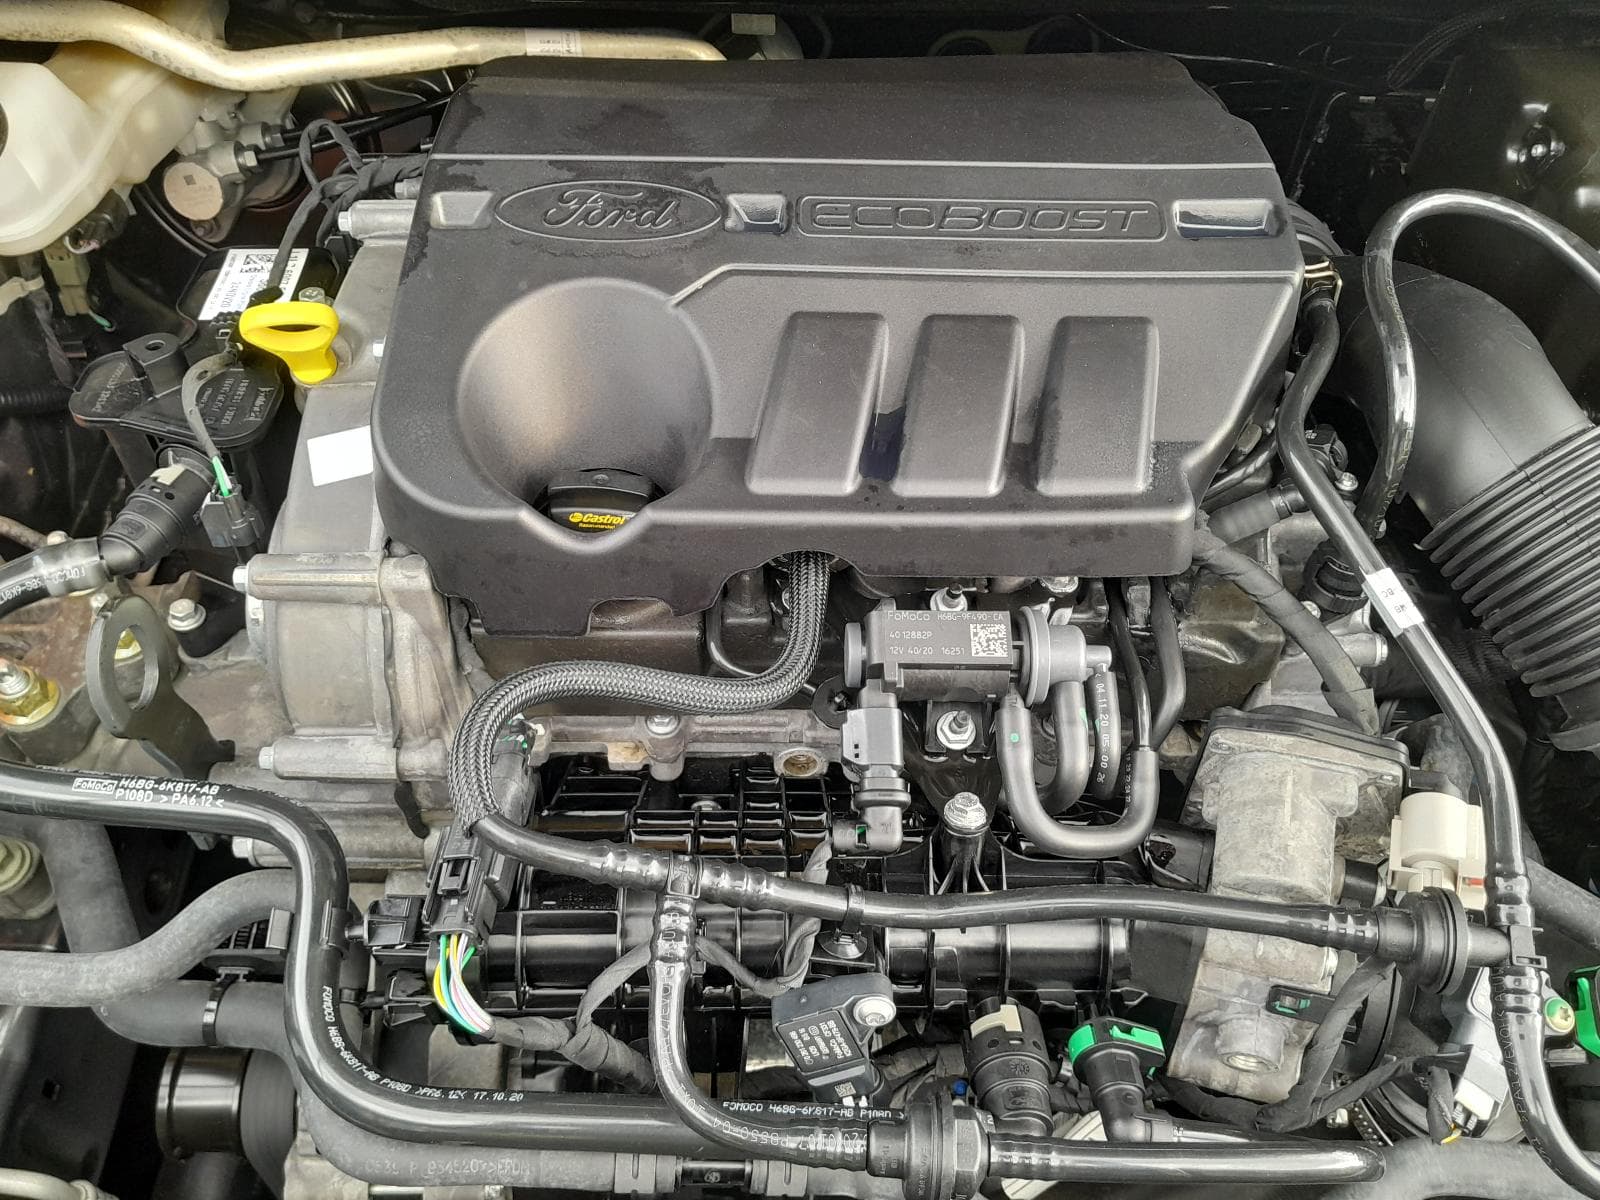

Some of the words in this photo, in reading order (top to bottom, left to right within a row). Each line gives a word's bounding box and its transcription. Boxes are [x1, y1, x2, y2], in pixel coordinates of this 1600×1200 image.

[543, 189, 677, 229] Ford
[813, 202, 1149, 231] ECOBOOST
[582, 513, 625, 524] Castrol
[887, 611, 930, 621] FoMoCo
[889, 646, 904, 655] 12V
[73, 778, 116, 793] FoMoCo
[118, 777, 219, 795] H6BG-6K817-AB
[115, 788, 154, 801] P108D
[473, 1091, 524, 1102] 17.10.20
